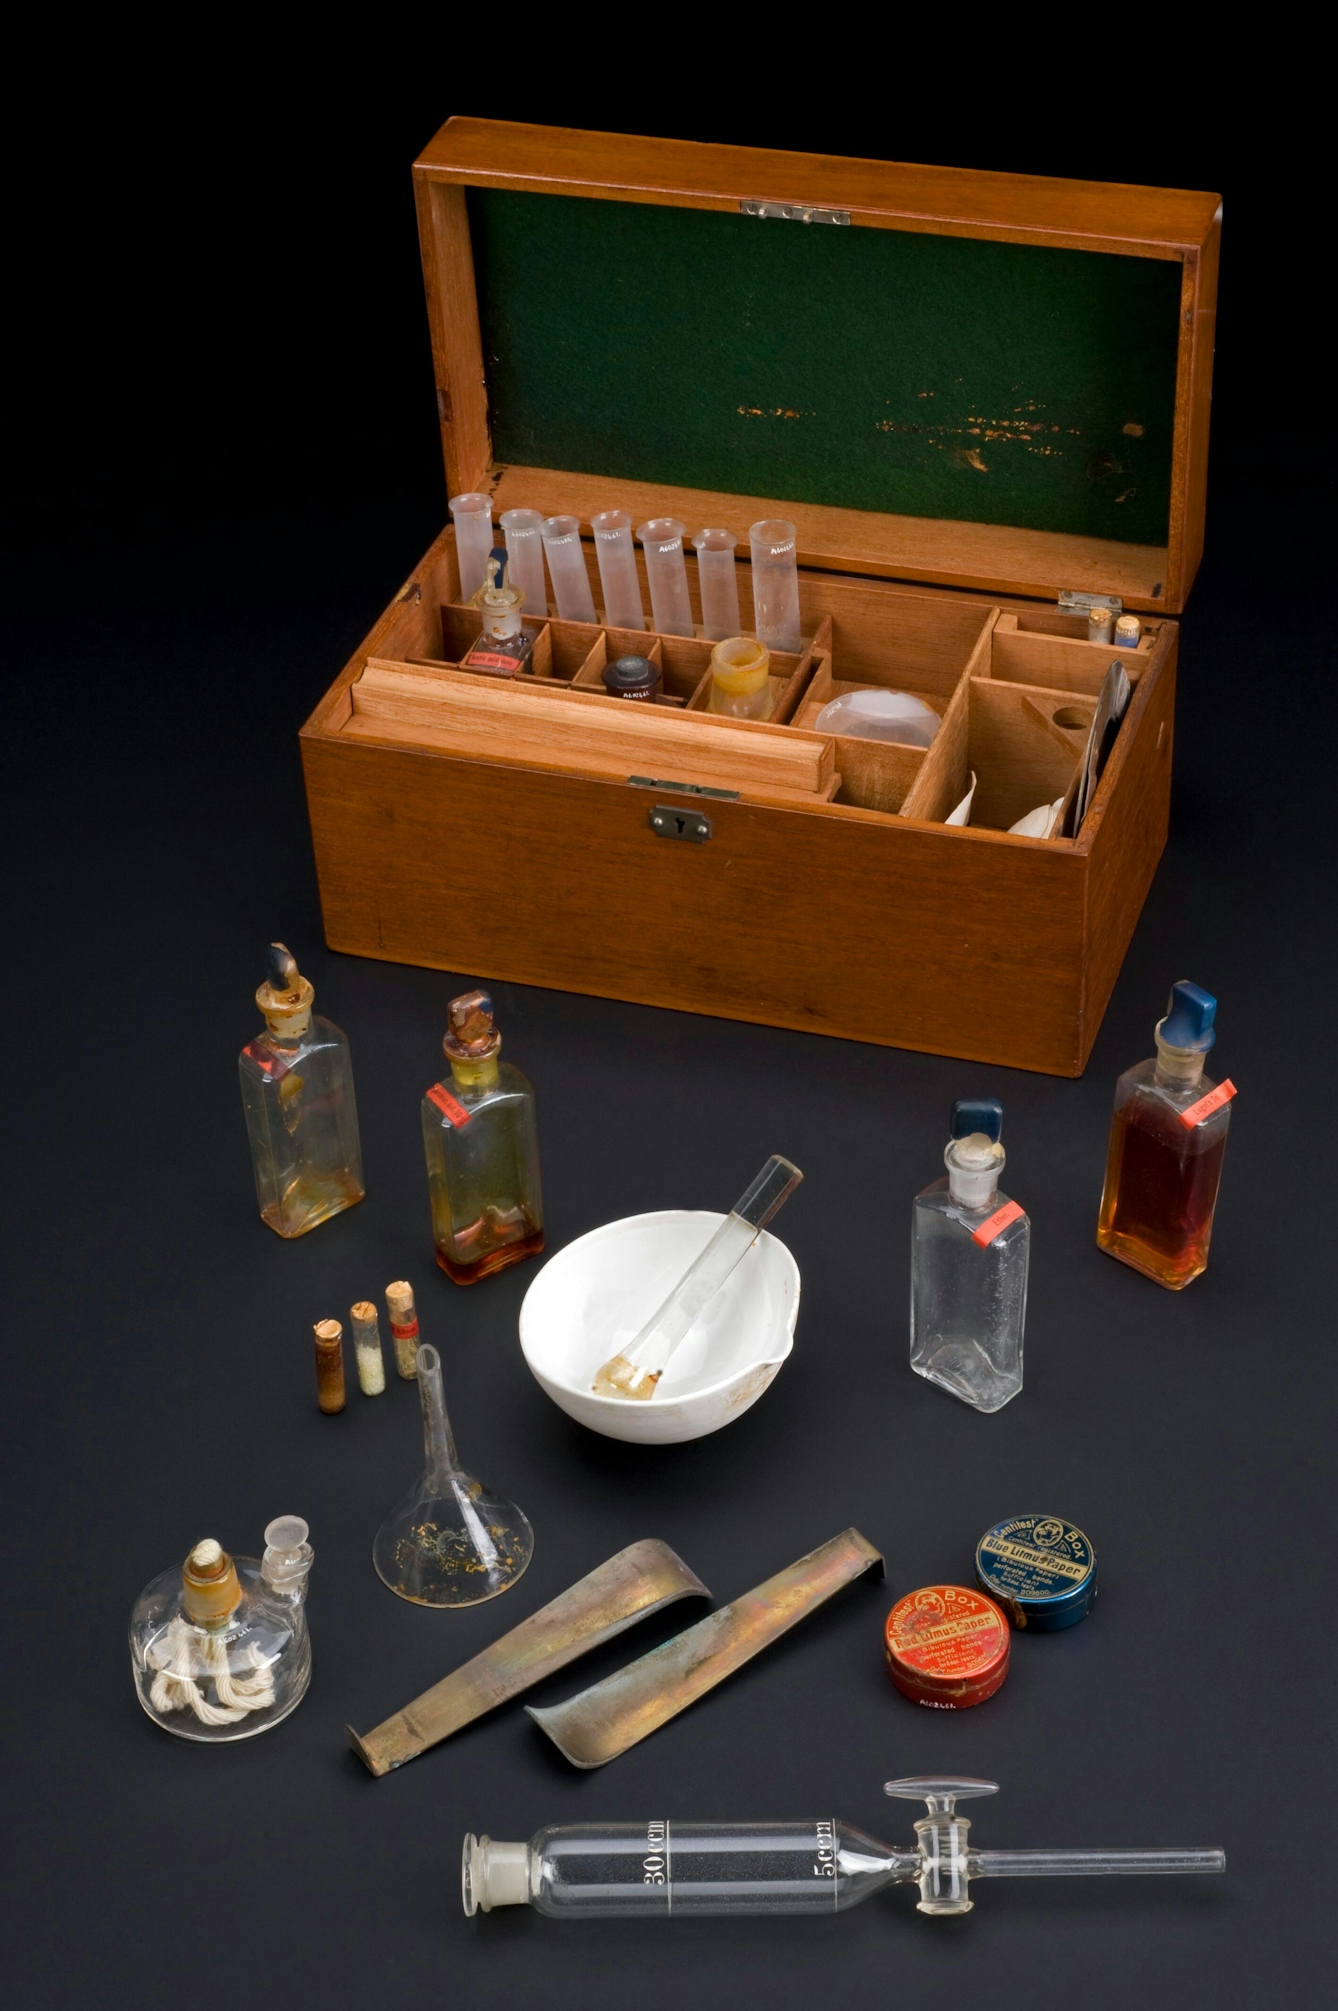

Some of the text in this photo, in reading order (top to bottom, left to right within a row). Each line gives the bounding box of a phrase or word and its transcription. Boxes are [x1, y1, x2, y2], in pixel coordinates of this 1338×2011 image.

[992, 1213, 1010, 1227] Ether.
[1064, 1531, 1086, 1558] Box
[986, 1538, 1009, 1553] Blue
[1010, 1546, 1045, 1565] Litmus
[1046, 1557, 1081, 1575] Paper
[944, 1590, 979, 1611] Box
[957, 1616, 992, 1632] Paper
